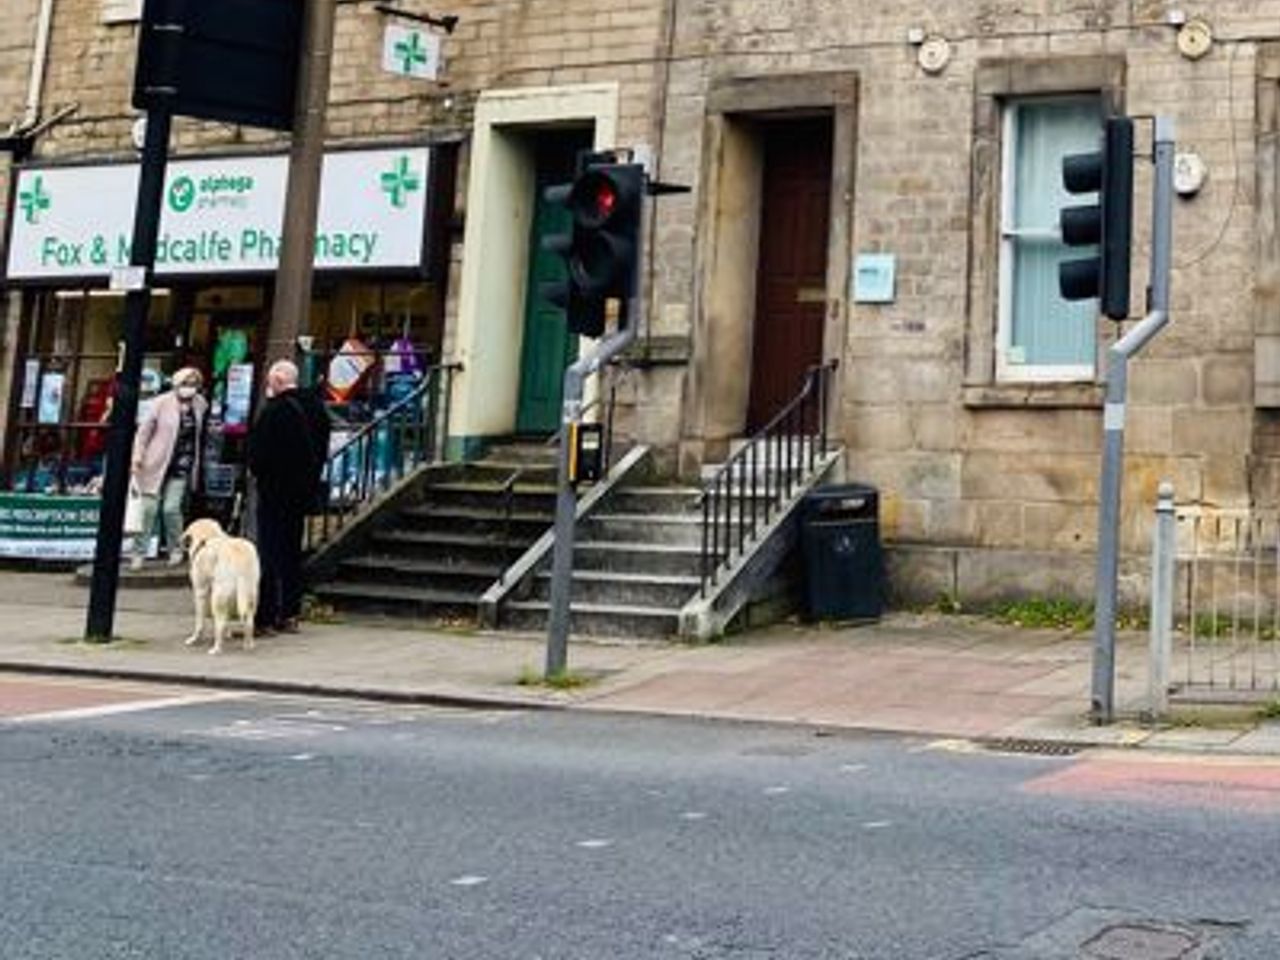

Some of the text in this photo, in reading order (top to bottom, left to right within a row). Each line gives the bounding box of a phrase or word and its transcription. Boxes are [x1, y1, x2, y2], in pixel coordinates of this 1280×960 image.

[200, 173, 254, 194] alphega
[41, 236, 84, 266] Fox
[89, 234, 106, 265] &
